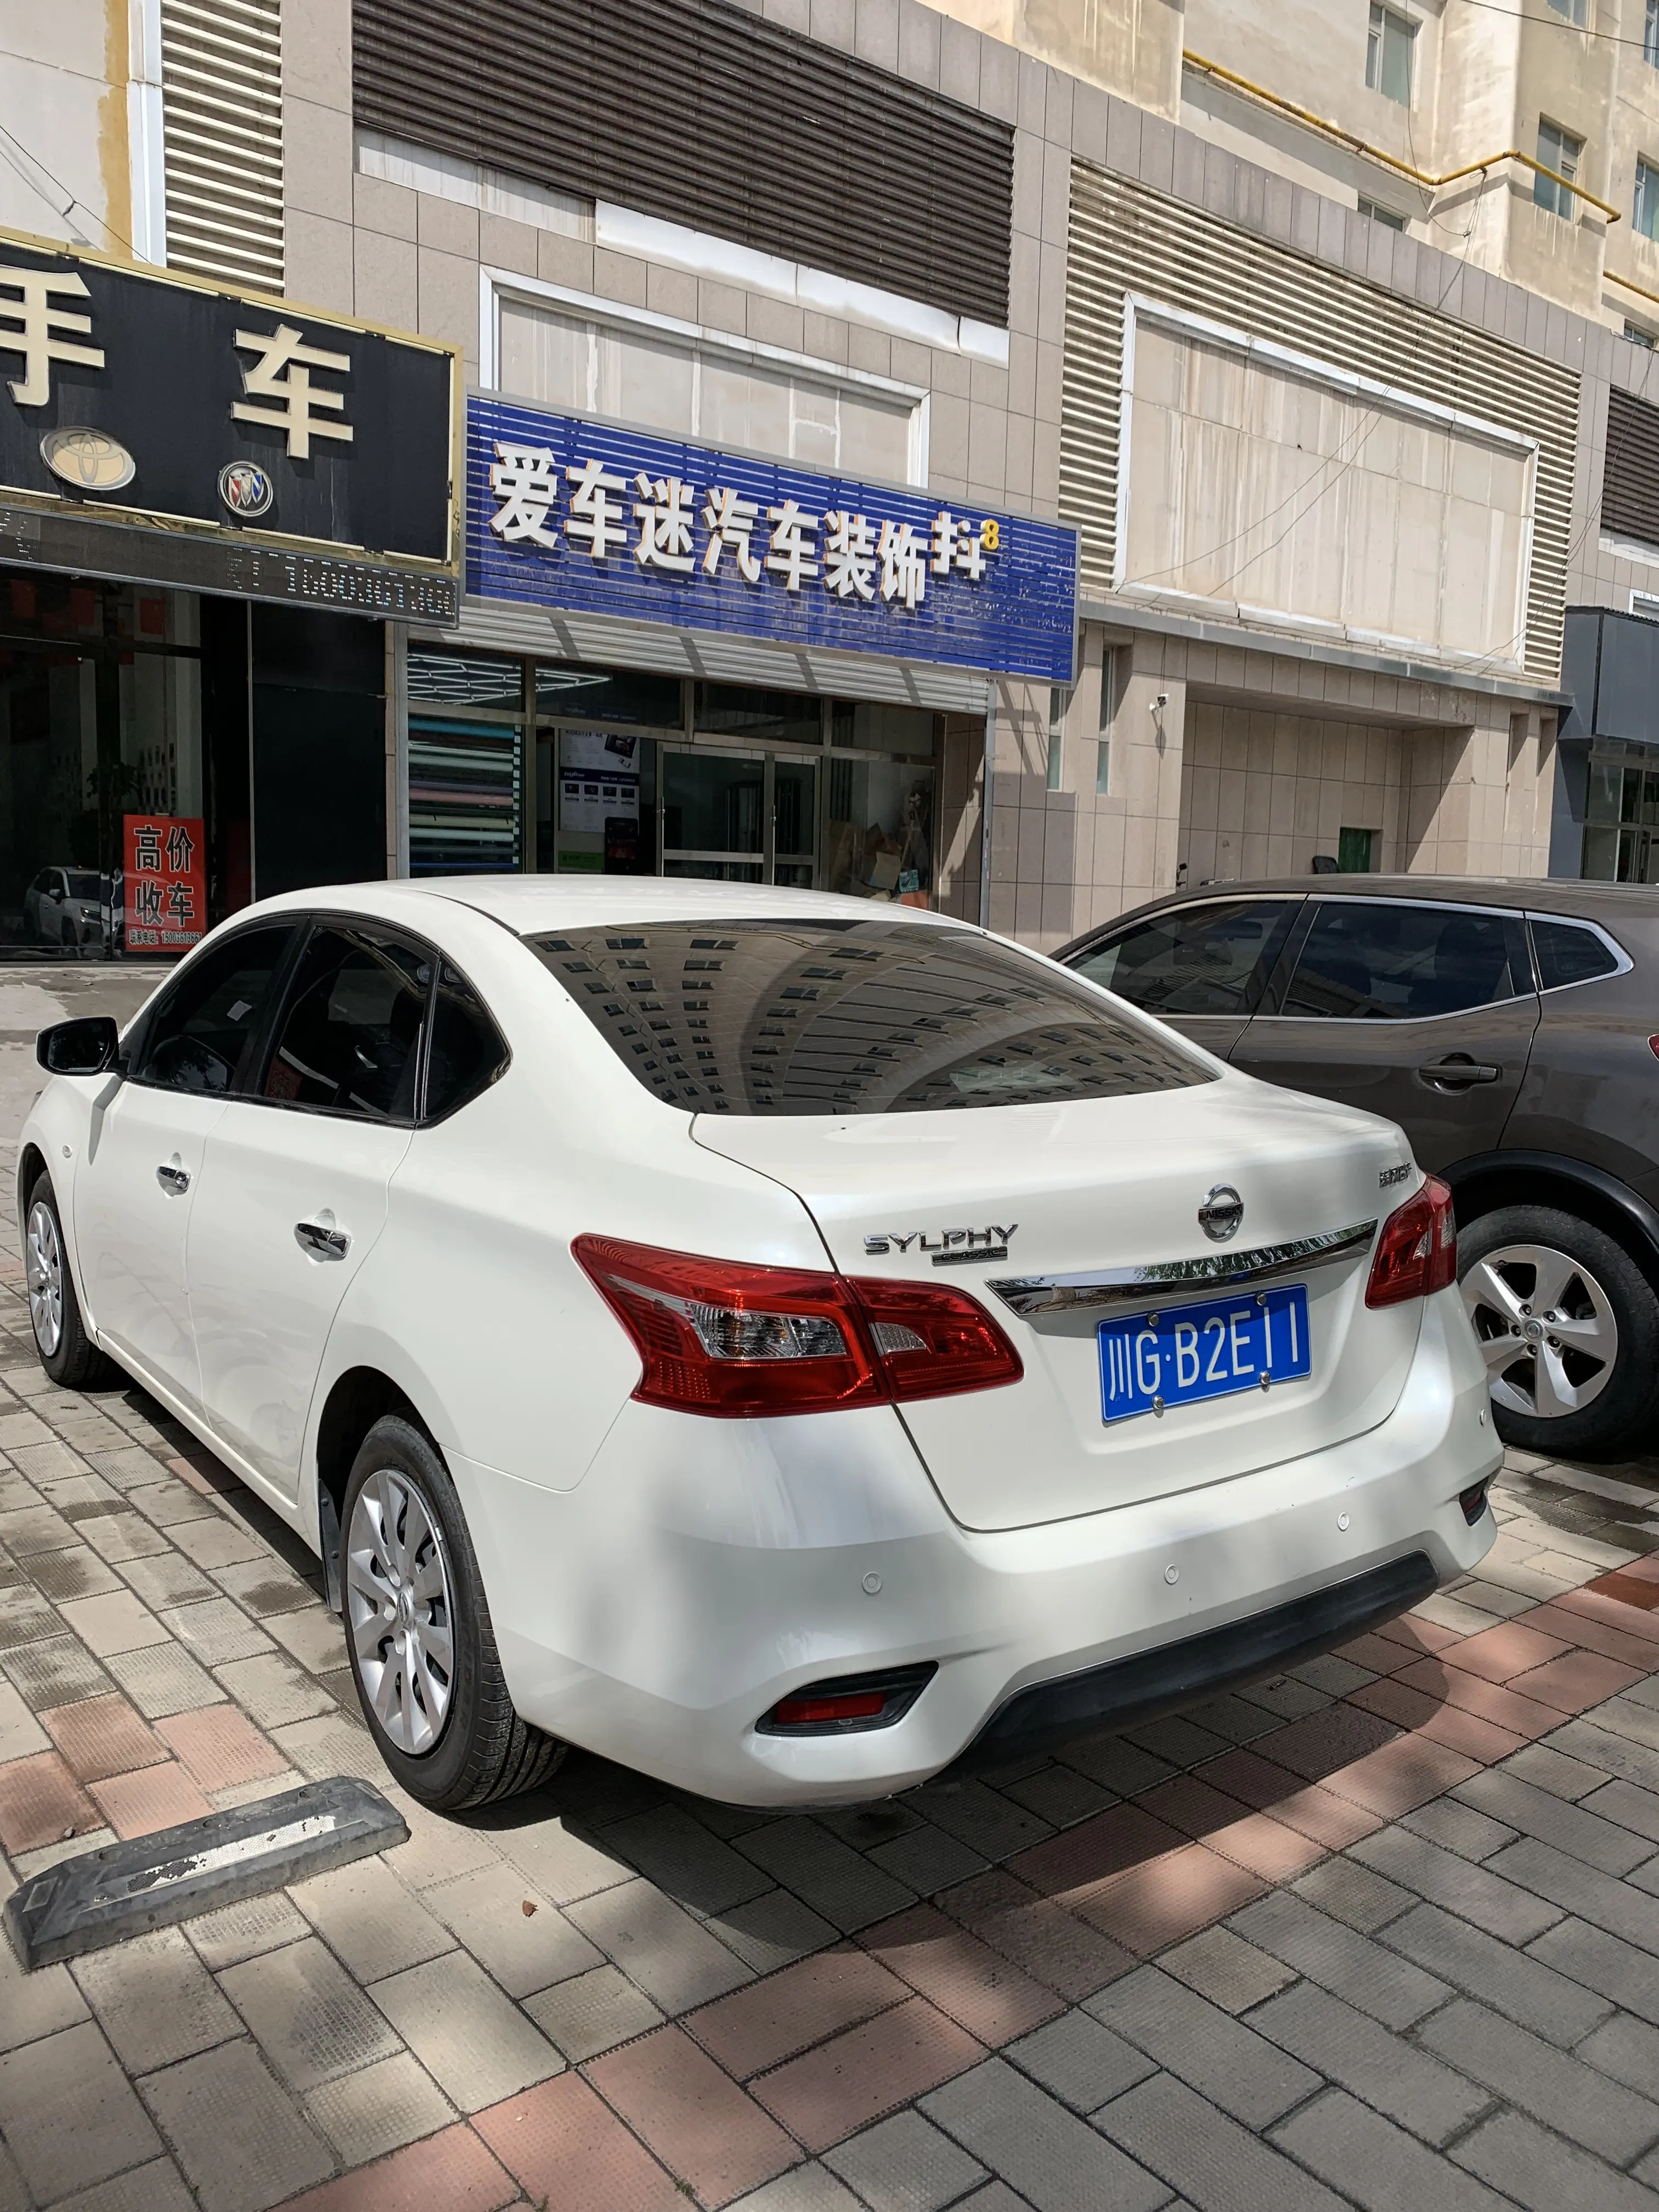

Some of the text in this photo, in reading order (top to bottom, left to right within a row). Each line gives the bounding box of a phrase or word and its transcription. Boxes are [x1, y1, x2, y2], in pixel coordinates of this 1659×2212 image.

[488, 442, 928, 610] 爱车迷汽车装饰
[134, 825, 195, 873] 高价
[134, 881, 195, 927] 收车
[1206, 1204, 1243, 1220] NISSAN
[864, 1223, 1019, 1255] SYLPHY
[941, 1249, 1001, 1262] CLASSIC
